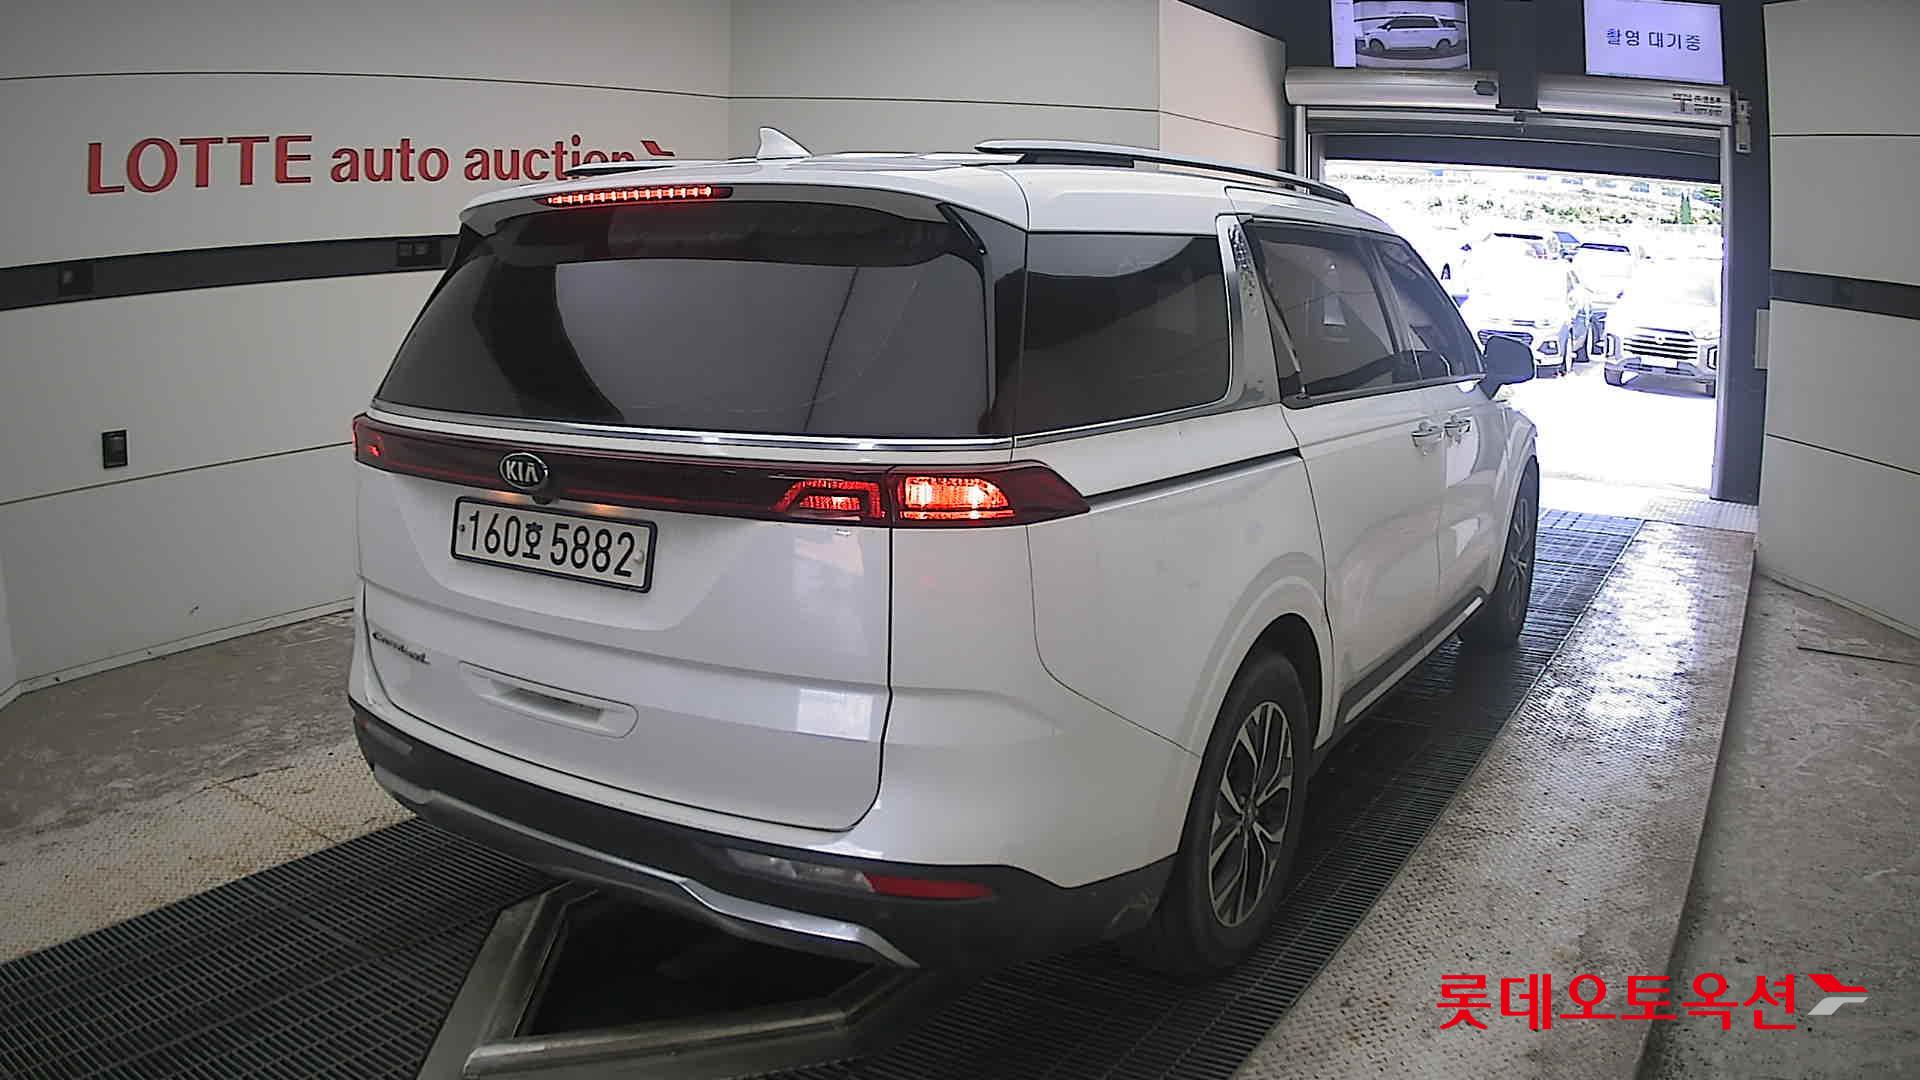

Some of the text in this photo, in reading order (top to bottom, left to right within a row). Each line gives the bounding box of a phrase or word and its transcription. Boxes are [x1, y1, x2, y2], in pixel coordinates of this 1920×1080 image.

[1607, 28, 1701, 51] 촬영 대기중
[88, 135, 312, 195] LOTTE
[330, 138, 449, 182] auto
[505, 460, 540, 483] KIA
[550, 523, 635, 577] 5882
